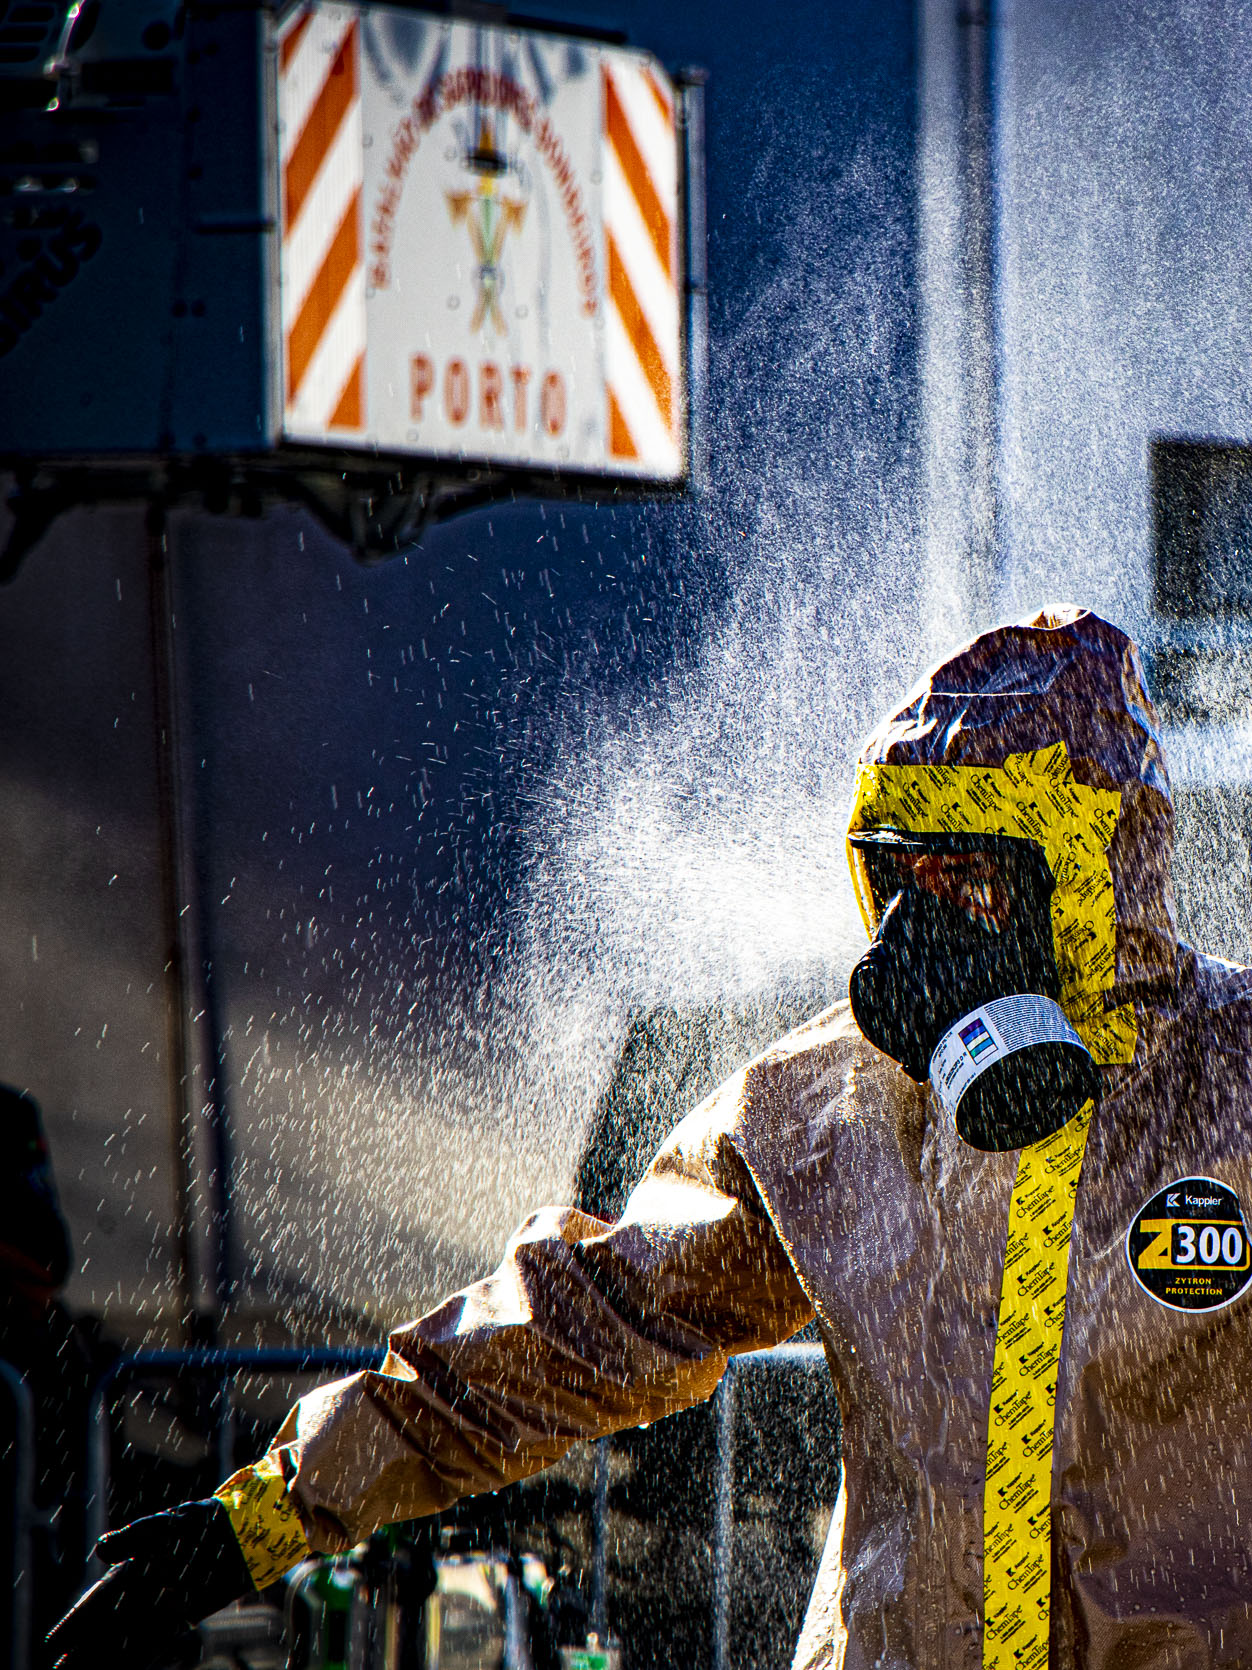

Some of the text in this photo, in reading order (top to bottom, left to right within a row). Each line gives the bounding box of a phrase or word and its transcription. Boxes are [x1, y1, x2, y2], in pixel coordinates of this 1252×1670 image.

[408, 352, 566, 439] PORTO
[1185, 1194, 1222, 1207] Kappler
[1175, 1277, 1212, 1285] ZYTRON
[1165, 1287, 1223, 1296] PROTECTION
